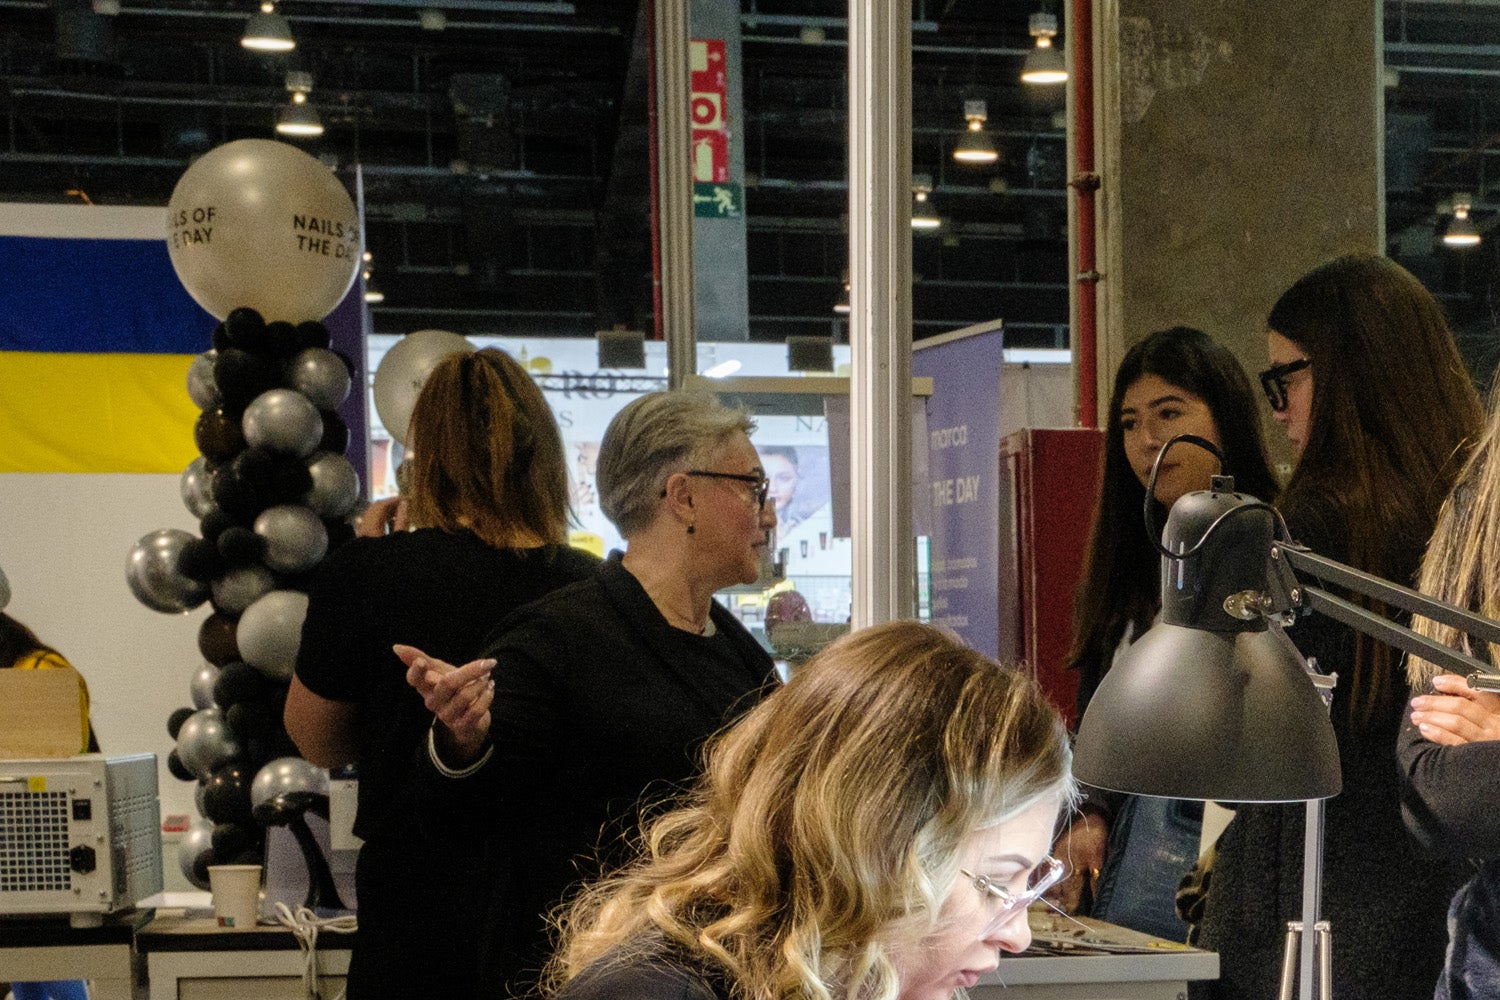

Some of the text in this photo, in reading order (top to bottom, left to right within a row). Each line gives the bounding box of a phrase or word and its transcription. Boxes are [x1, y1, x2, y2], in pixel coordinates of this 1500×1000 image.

[192, 206, 217, 224] OF
[293, 214, 344, 239] NAILS
[297, 234, 330, 256] THE
[956, 474, 981, 504] DAY
